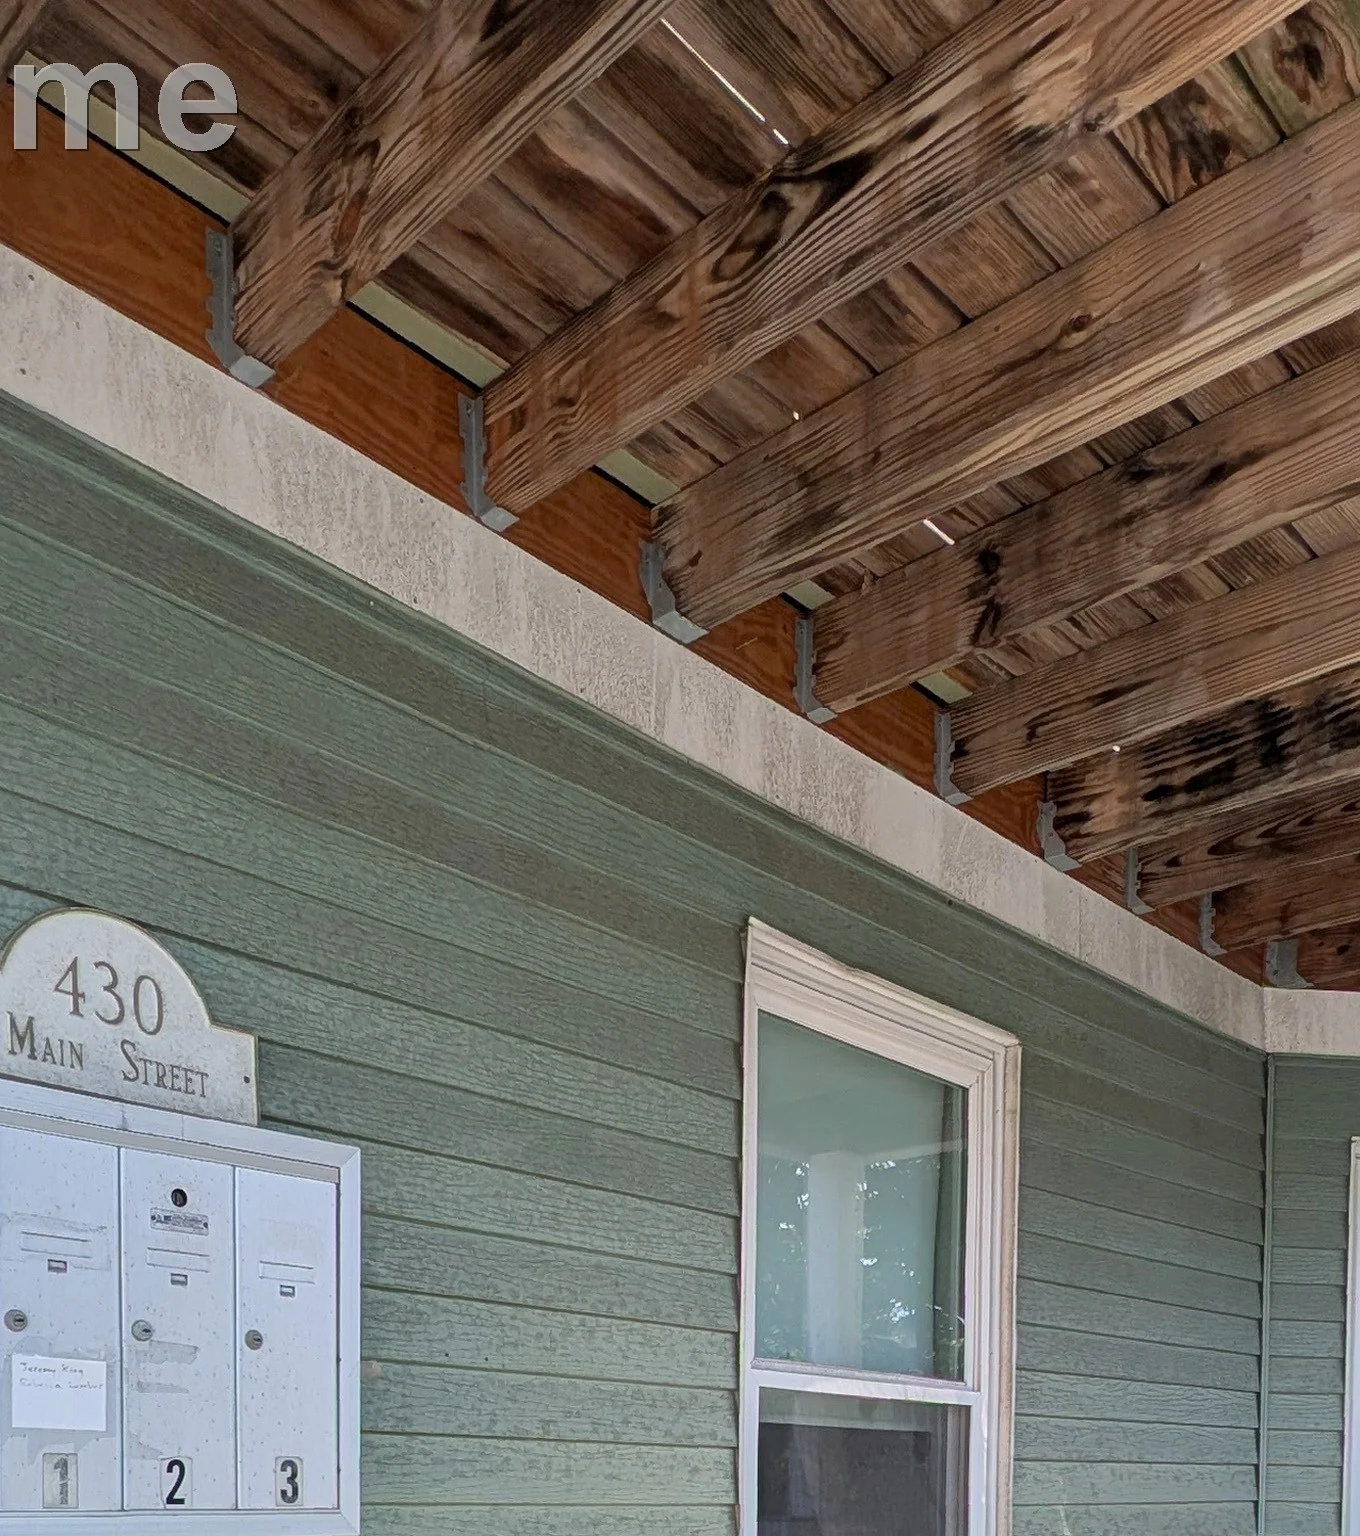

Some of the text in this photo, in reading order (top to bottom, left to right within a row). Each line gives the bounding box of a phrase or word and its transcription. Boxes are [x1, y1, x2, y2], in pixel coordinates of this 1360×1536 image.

[54, 956, 164, 1036] 430
[53, 1456, 70, 1505] 1
[166, 1458, 186, 1505] 2
[280, 1459, 299, 1504] 3
